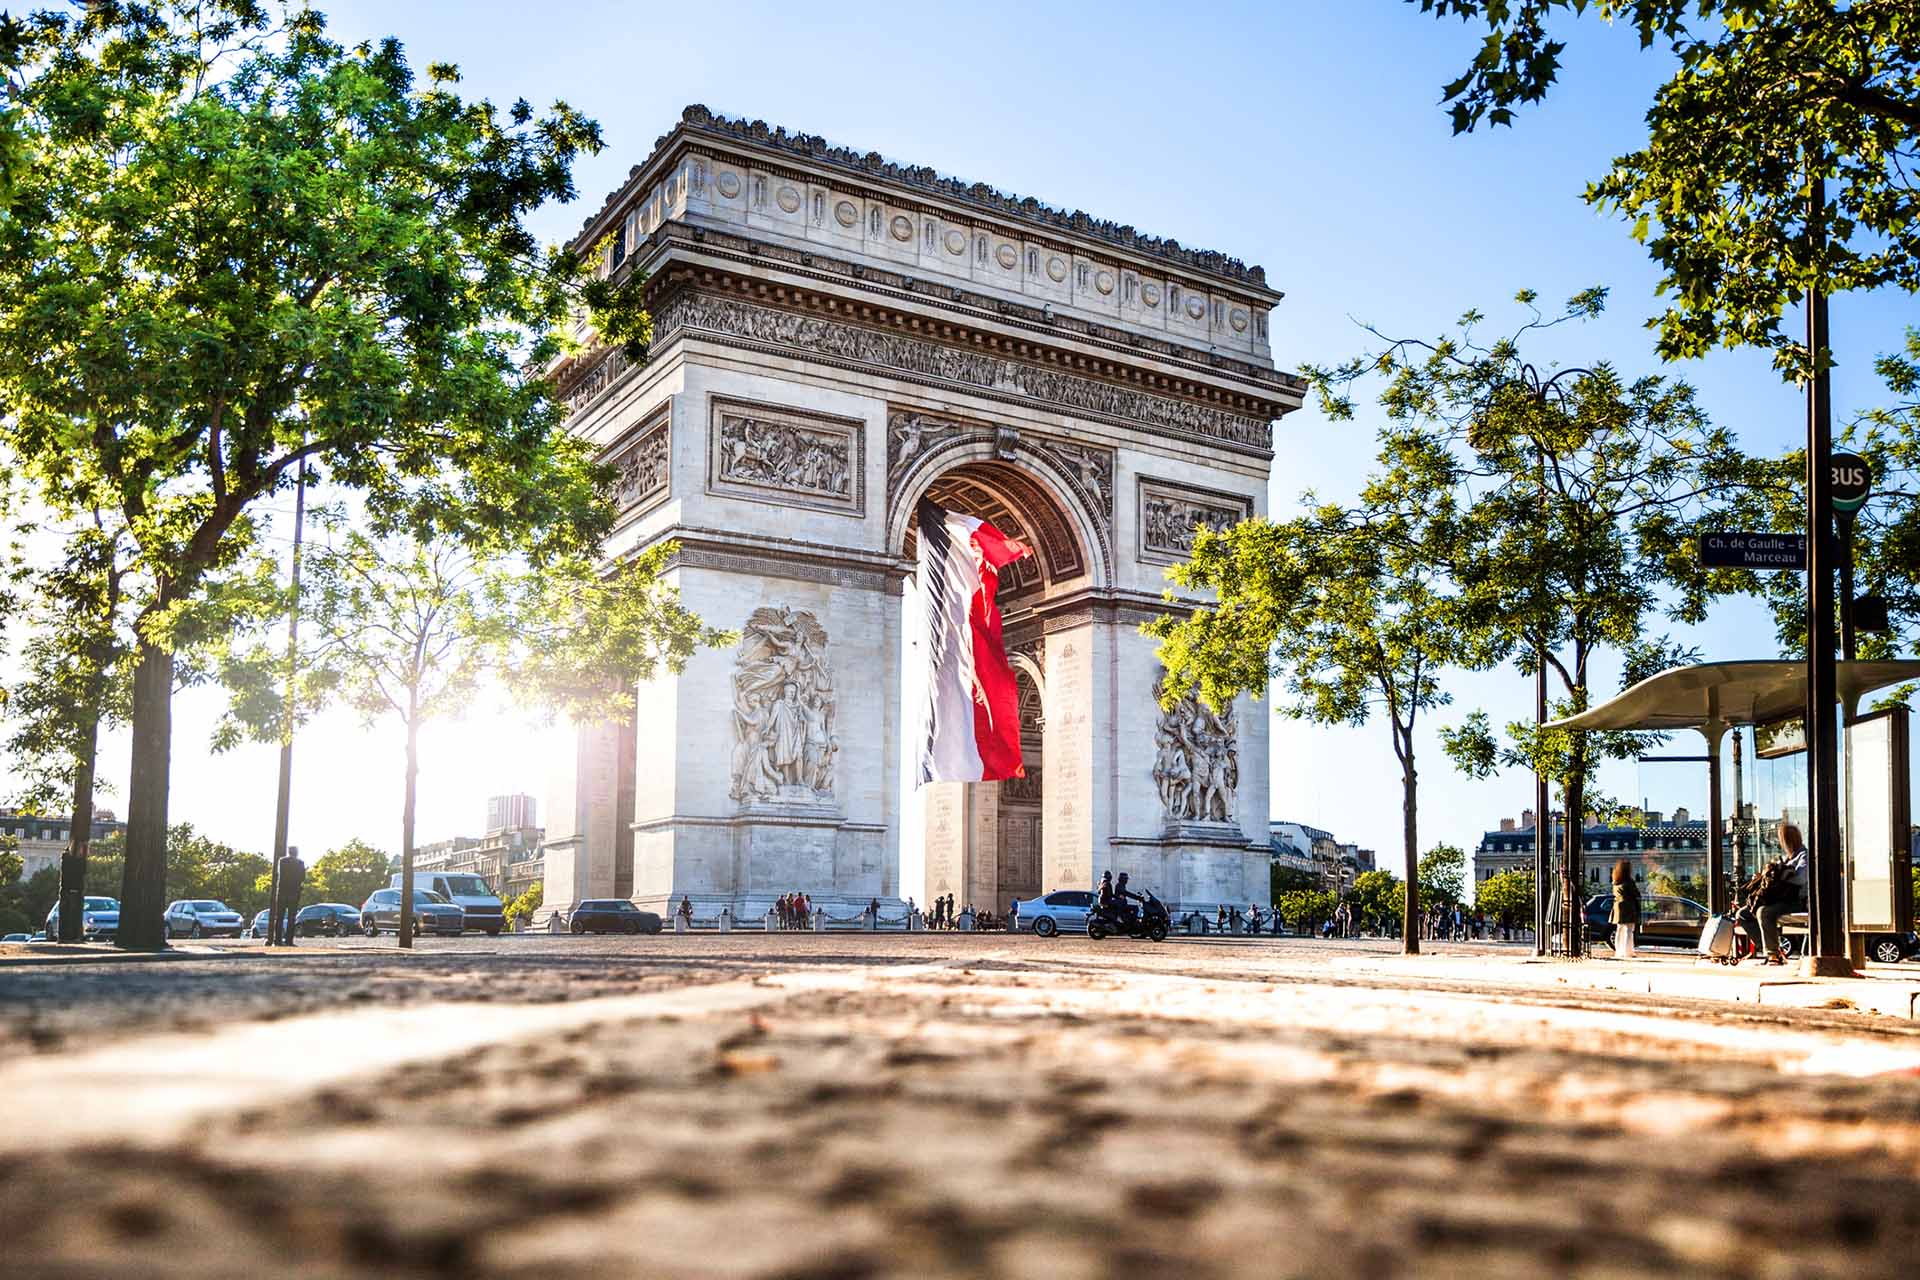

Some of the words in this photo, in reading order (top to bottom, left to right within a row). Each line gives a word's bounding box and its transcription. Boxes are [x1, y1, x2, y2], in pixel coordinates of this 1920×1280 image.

[1831, 467, 1864, 486] BUS
[1708, 537, 1727, 549] Ch.
[1730, 538, 1745, 549] de
[1748, 538, 1785, 550] Gaulle
[1744, 552, 1797, 562] Marceau
